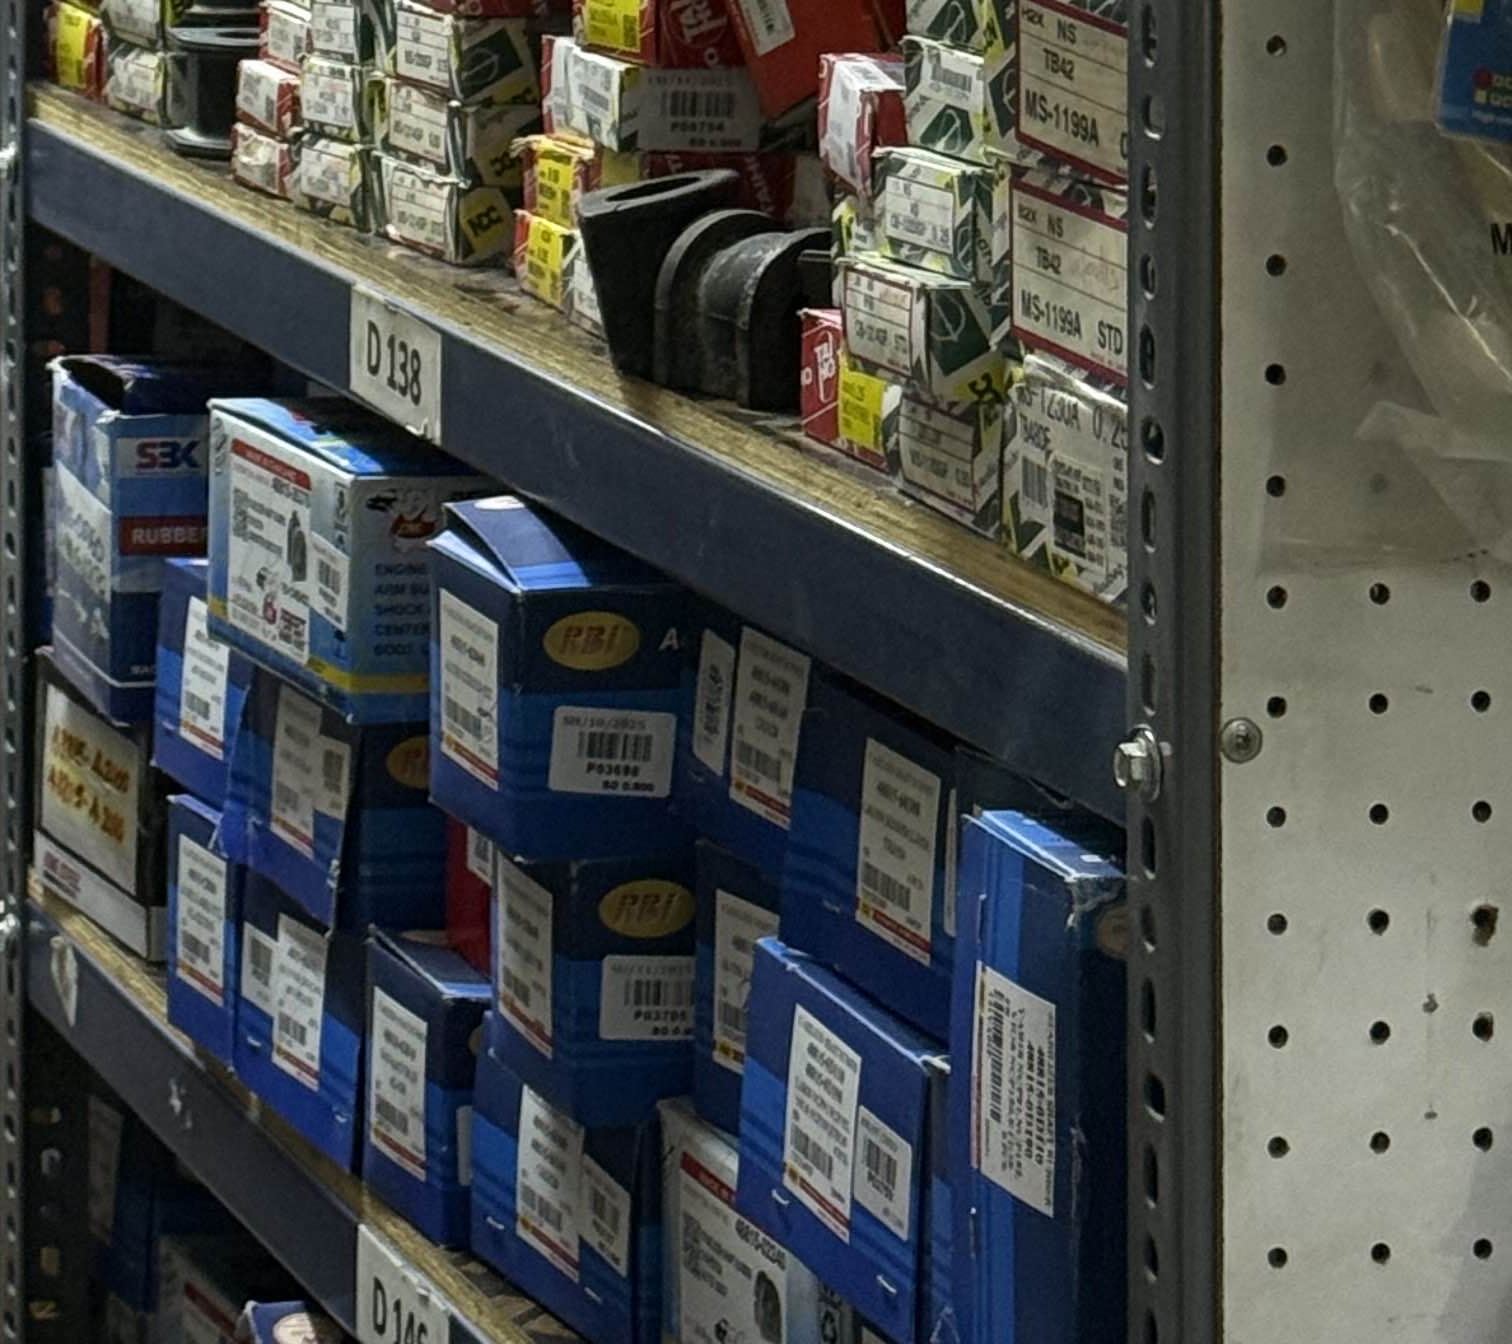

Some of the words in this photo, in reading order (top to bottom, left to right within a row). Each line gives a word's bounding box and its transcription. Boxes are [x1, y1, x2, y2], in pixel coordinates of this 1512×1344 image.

[1056, 18, 1077, 45] NS
[1042, 47, 1076, 81] TB42
[1024, 88, 1100, 149] MS-1199A
[1019, 288, 1083, 341] MS-1199A
[1096, 324, 1124, 353] STD
[365, 321, 381, 377] D
[387, 337, 422, 407] 138
[372, 1275, 388, 1337] D
